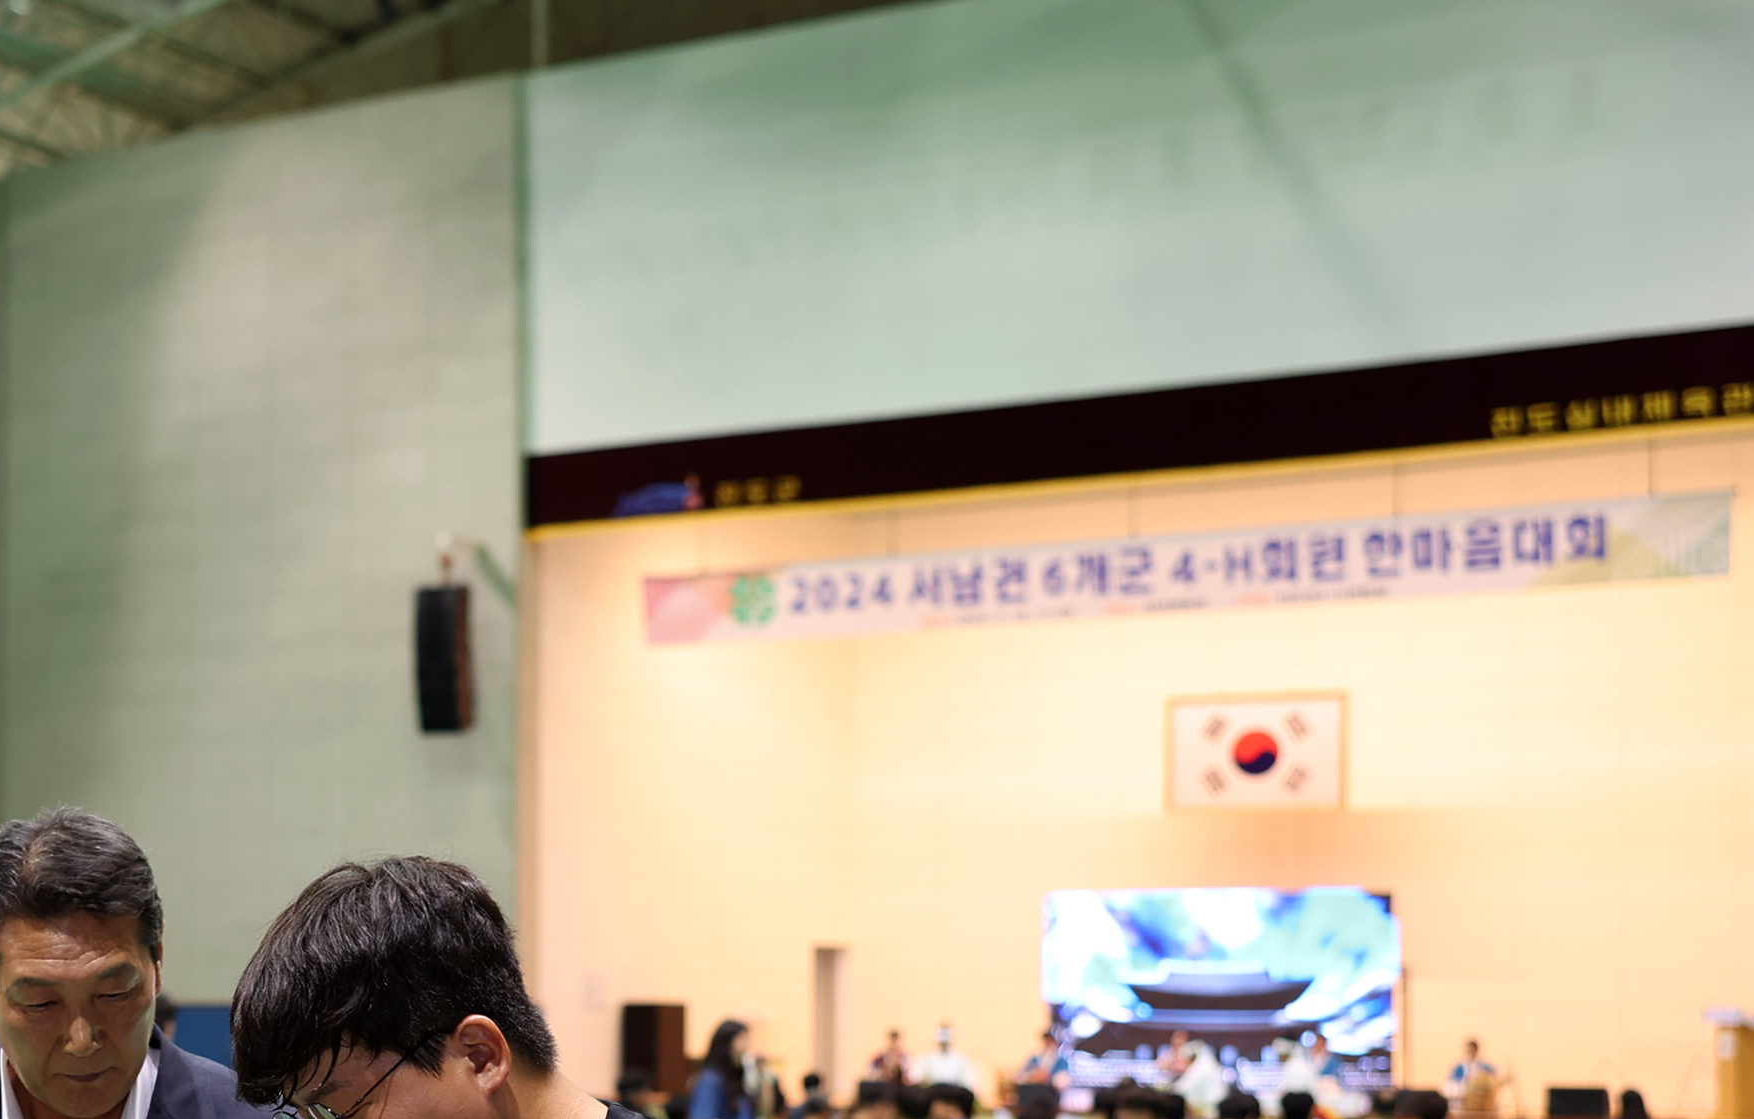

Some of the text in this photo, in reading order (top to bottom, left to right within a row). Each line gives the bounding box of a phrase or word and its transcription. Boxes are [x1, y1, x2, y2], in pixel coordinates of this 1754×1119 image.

[789, 512, 1609, 614] 2024 서남권 6개군 4-H회원 한마음대회
